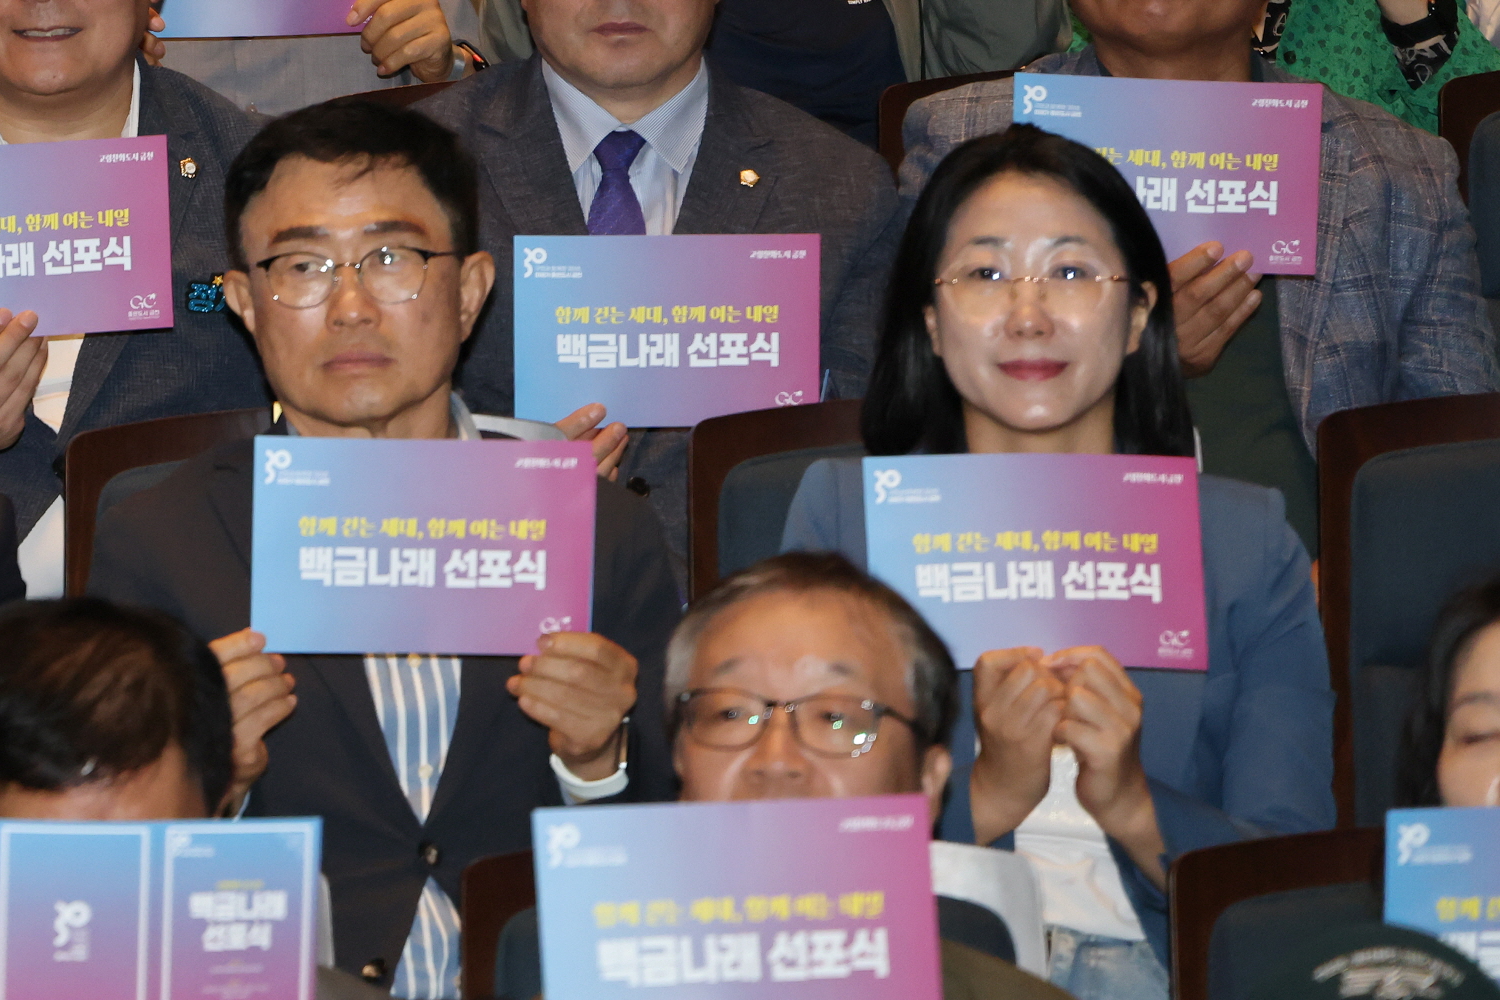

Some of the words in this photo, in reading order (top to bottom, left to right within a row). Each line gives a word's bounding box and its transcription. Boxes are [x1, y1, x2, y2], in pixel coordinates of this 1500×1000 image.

[1185, 179, 1278, 216] 선포식
[25, 212, 59, 232] 함께
[62, 210, 94, 229] 여는
[97, 208, 129, 228] 내일
[42, 235, 131, 275] 선포식
[555, 307, 589, 324] 함께
[671, 305, 706, 323] 함께
[710, 305, 742, 322] 여는
[746, 304, 778, 323] 내일
[557, 333, 679, 368] 백금나래
[687, 332, 778, 367] 선포식
[299, 547, 435, 587] 백금나래
[443, 549, 545, 589] 선포식
[916, 562, 1053, 601] 백금나래
[1061, 562, 1161, 600] 선포식
